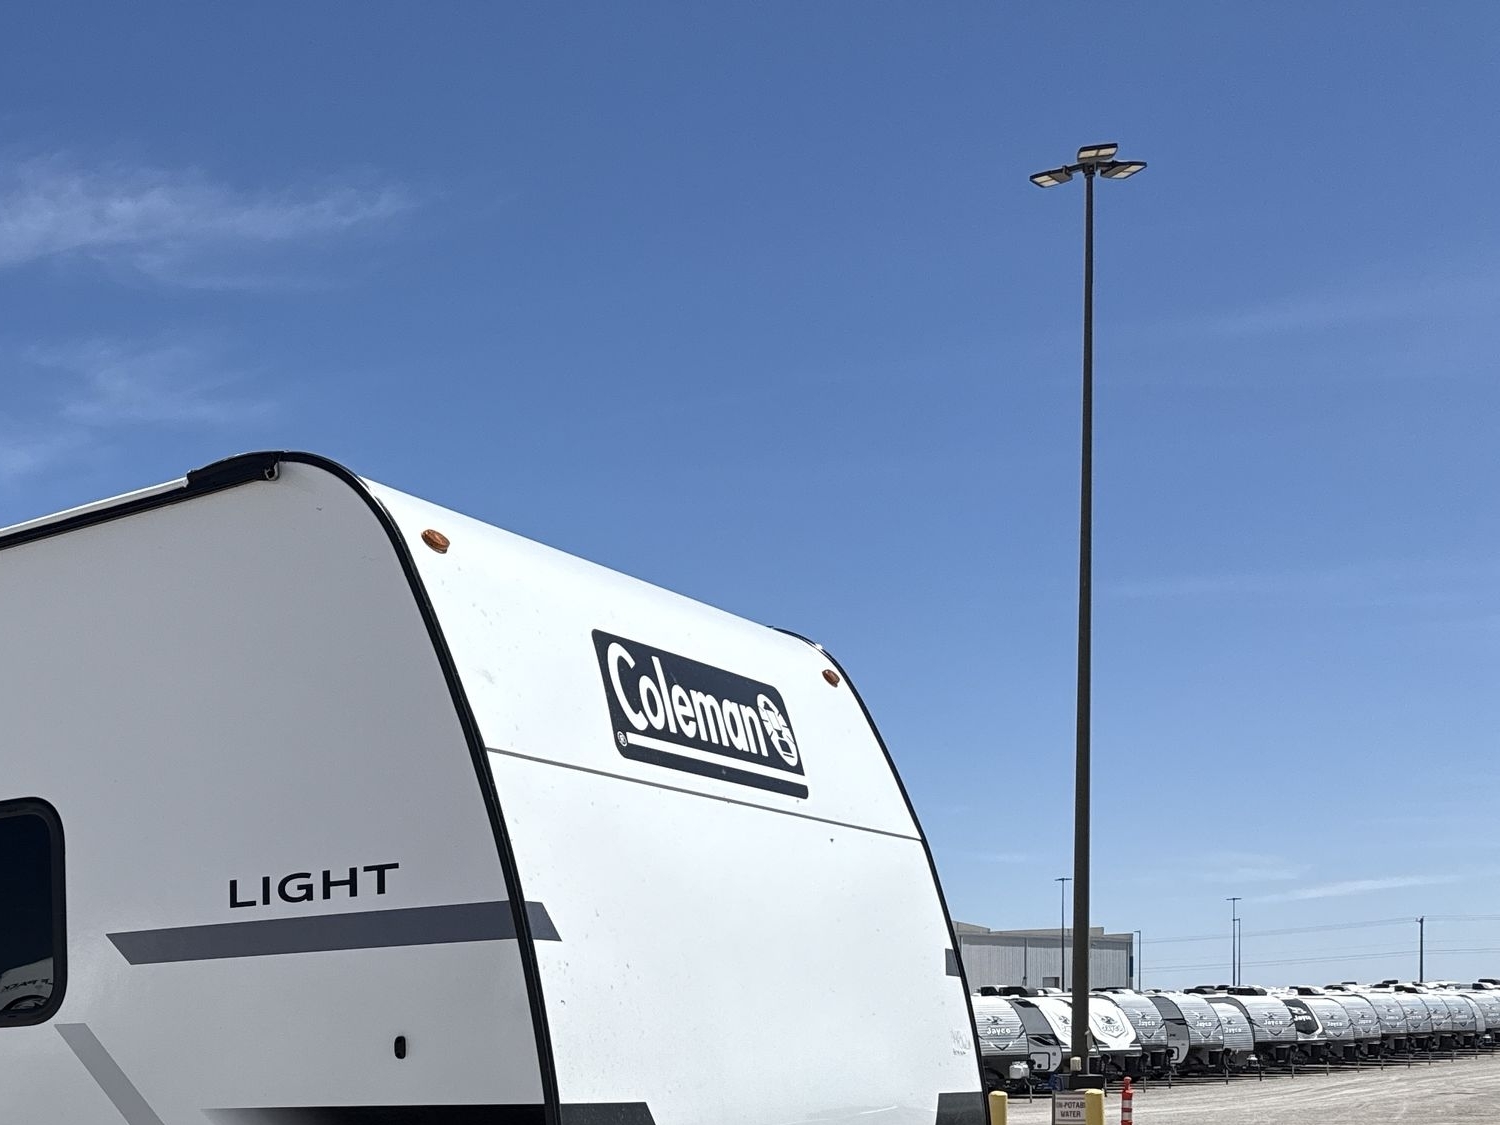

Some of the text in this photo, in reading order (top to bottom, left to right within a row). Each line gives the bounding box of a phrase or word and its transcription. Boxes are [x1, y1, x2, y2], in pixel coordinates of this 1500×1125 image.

[607, 642, 769, 757] Coleman
[229, 862, 400, 909] LIGHT
[987, 1026, 1011, 1035] Jayco
